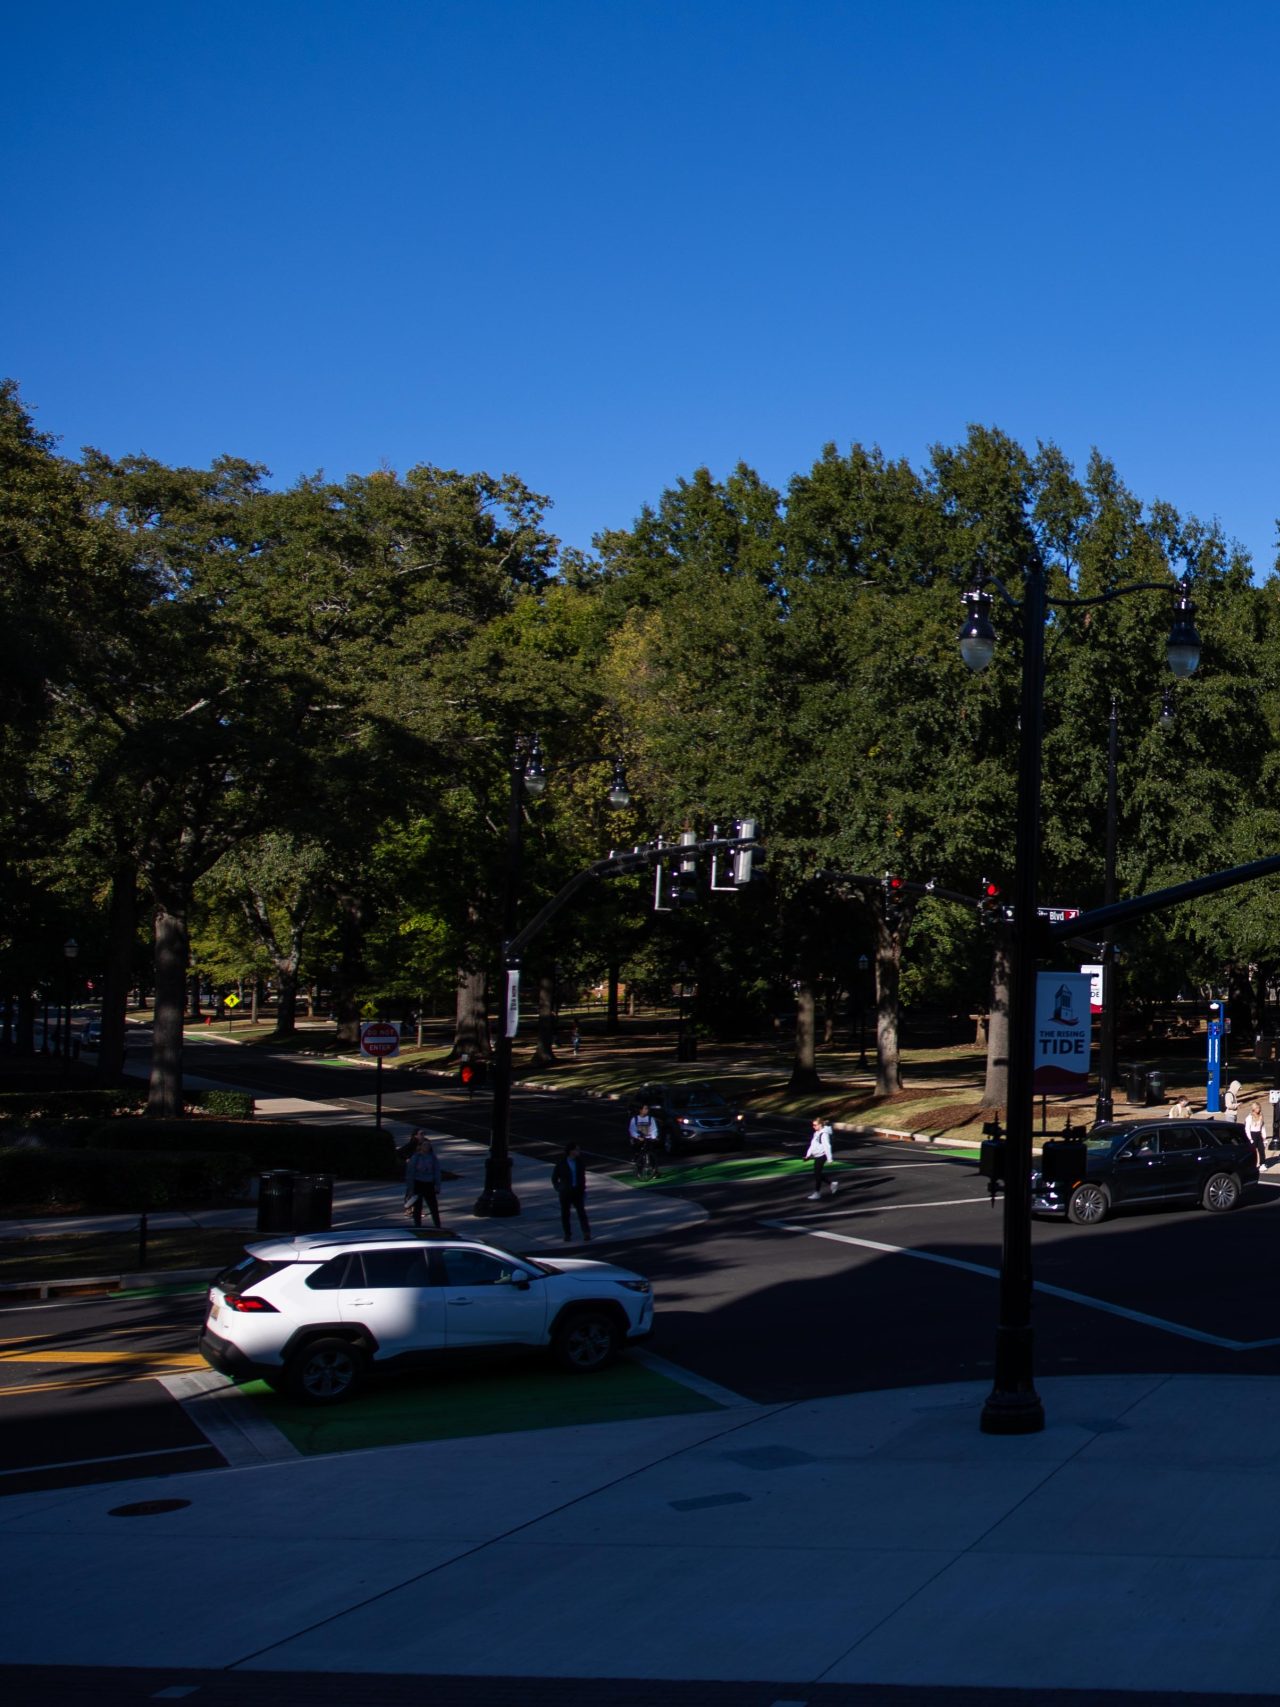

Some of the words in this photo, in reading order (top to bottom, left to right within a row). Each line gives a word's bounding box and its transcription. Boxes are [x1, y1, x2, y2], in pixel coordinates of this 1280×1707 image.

[1050, 911, 1064, 920] Blvd
[1040, 1030, 1055, 1038] THE
[1057, 1030, 1086, 1038] RISING
[1039, 1039, 1085, 1054] TIDE
